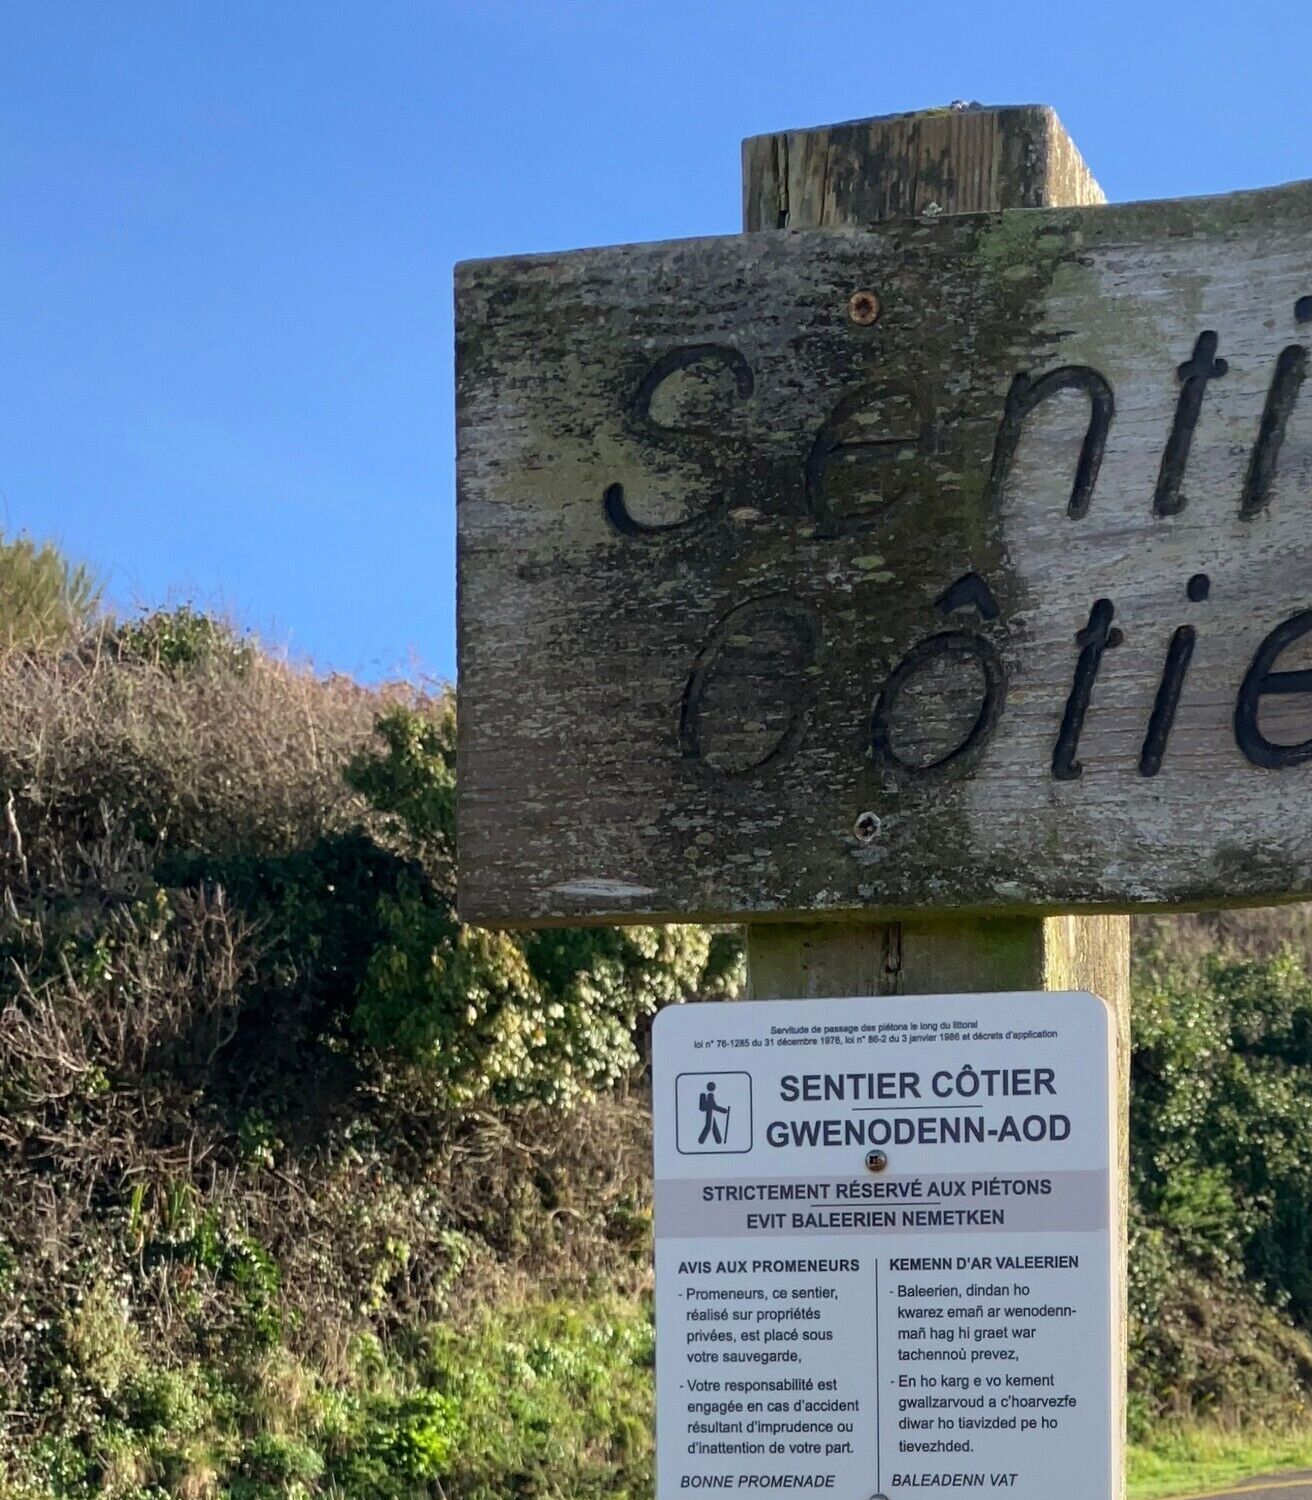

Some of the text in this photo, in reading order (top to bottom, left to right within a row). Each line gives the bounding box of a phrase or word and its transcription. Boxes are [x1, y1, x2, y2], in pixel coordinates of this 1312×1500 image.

[771, 1026, 809, 1034] Servitude
[824, 1026, 858, 1034] passage
[861, 1024, 876, 1032] des
[878, 1023, 908, 1033] piétons
[910, 1022, 918, 1030] le
[920, 1022, 938, 1032] long
[953, 1020, 978, 1029] littoral
[780, 1064, 1056, 1101] SENTIER CÔTIER
[767, 1115, 1070, 1147] GWENODENN-AOD
[703, 1177, 1051, 1201] STRICTEMENT RÉSERVÉ AUX PIÉTONS
[747, 1209, 1004, 1229] EVIT BALEERIEN NEMETKEN
[678, 1259, 859, 1274] AVIS AUX PROMENEURS
[890, 1256, 1078, 1271] KEMENN D'AR VALEERIEN
[687, 1288, 768, 1301] Promeneurs,
[773, 1290, 787, 1299] ce
[792, 1286, 838, 1300] sentier,
[898, 1285, 961, 1298] Baleerien,
[966, 1284, 1009, 1296] dindan
[1014, 1283, 1030, 1296] ho
[687, 1307, 820, 1323] réalisé sur propriétés
[898, 1305, 1076, 1318] kwarez emañ ar wenodenn-
[687, 1328, 833, 1345] privées, est placé sous
[898, 1327, 1036, 1342] mañ hag hi graet war
[687, 1350, 801, 1365] votre sauvegarde,
[898, 1348, 1018, 1363] tachennoù prevez,
[687, 1379, 720, 1391] Votre
[725, 1378, 813, 1394] responsabilité
[818, 1379, 837, 1390] est
[899, 1375, 916, 1387] En
[921, 1375, 937, 1387] ho
[941, 1375, 969, 1389] karg
[974, 1377, 981, 1386] e
[986, 1377, 1001, 1386] vo
[1006, 1374, 1054, 1386] kement
[688, 1399, 859, 1415] engagée en cas d'accident
[989, 1398, 996, 1408] a
[1001, 1395, 1076, 1407] c'hoarvezfe
[688, 1421, 853, 1435] résultant d'imprudence ou
[899, 1417, 934, 1429] diwar
[938, 1417, 954, 1429] ho
[1021, 1419, 1037, 1431] pe
[1042, 1416, 1057, 1428] ho
[688, 1442, 765, 1454] d'inattention
[769, 1442, 785, 1453] de
[789, 1442, 821, 1453] votre
[681, 1475, 835, 1488] BONNE PROMENADE
[892, 1474, 1018, 1487] BALEADENN VAT
